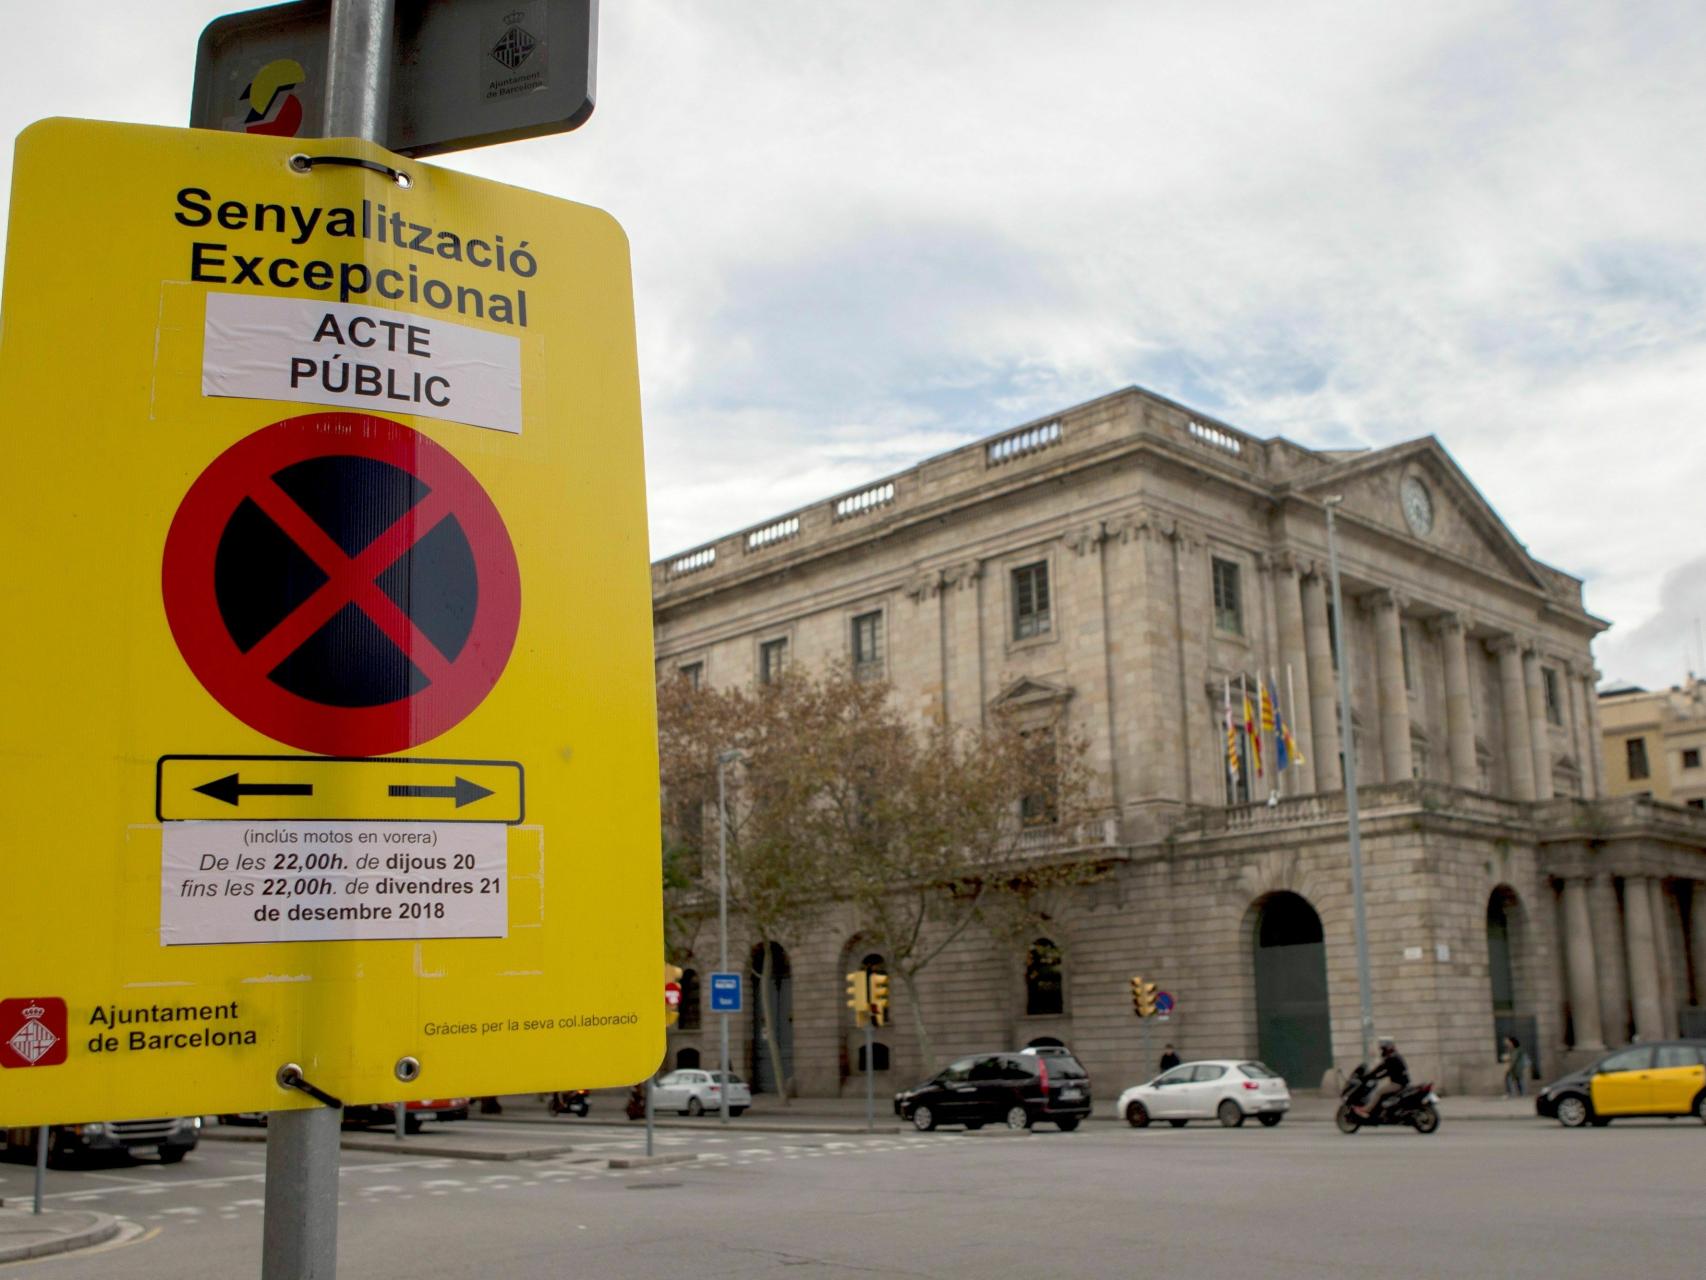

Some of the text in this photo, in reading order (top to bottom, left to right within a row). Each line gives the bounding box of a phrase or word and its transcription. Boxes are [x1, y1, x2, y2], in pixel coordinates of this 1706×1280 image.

[174, 187, 538, 279] Senyalització
[190, 242, 528, 327] Excepcional
[312, 313, 431, 358] ACTE
[289, 354, 451, 407] PÚBLIC
[243, 829, 438, 848] (inclús motos en vorera)
[199, 853, 476, 874] De les 22,00h. de dijous 20
[180, 878, 501, 898] fins les 22,00h. de divendres 21
[253, 903, 445, 922] de desembre 2018
[89, 1001, 239, 1030] Ajuntament
[482, 1021, 503, 1035] per
[507, 1019, 519, 1031] la
[523, 1018, 555, 1031] seva
[88, 1028, 257, 1053] de Barcelona
